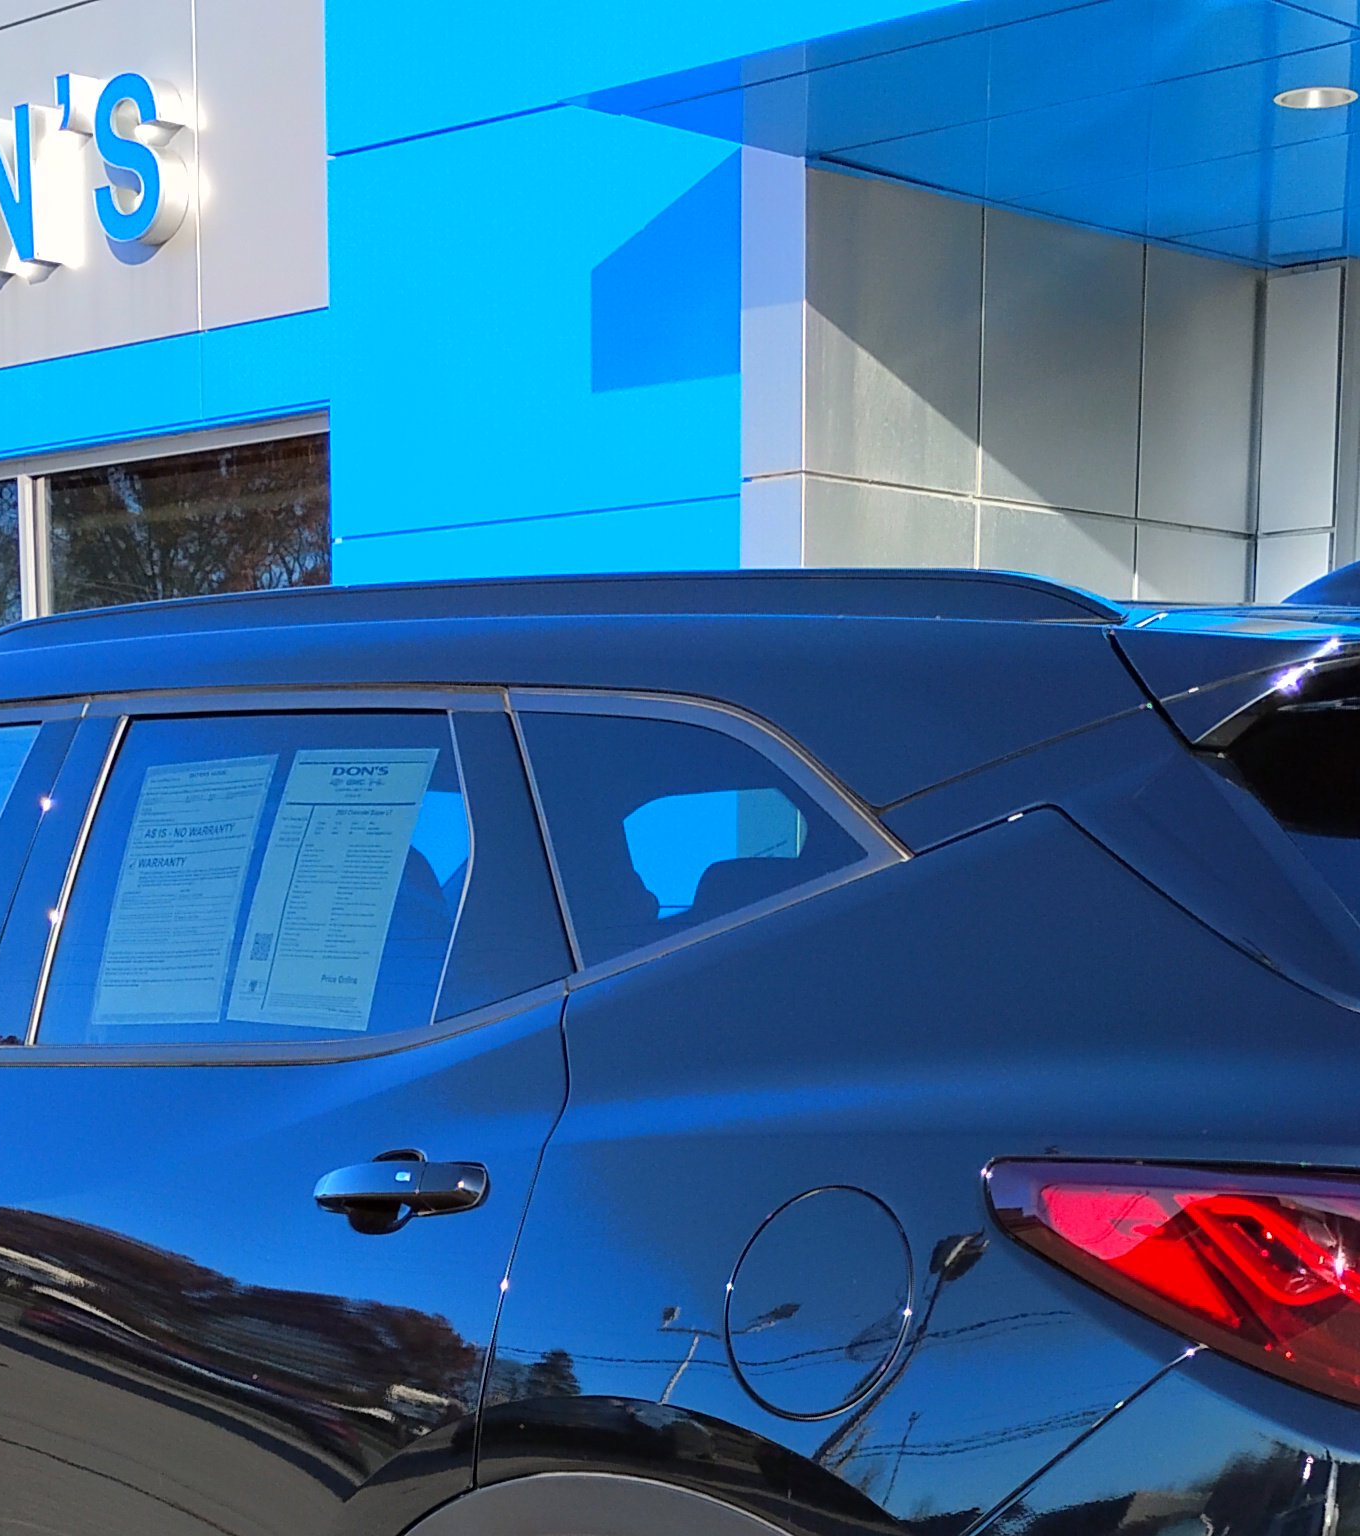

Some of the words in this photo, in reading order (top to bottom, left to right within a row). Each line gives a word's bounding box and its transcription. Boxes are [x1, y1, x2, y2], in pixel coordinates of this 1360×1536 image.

[332, 766, 389, 776] DON'S
[145, 829, 157, 839] AS
[158, 828, 167, 838] IS
[174, 827, 188, 838] NO
[189, 823, 236, 837] WARRANTY
[138, 856, 188, 868] WARRANTY
